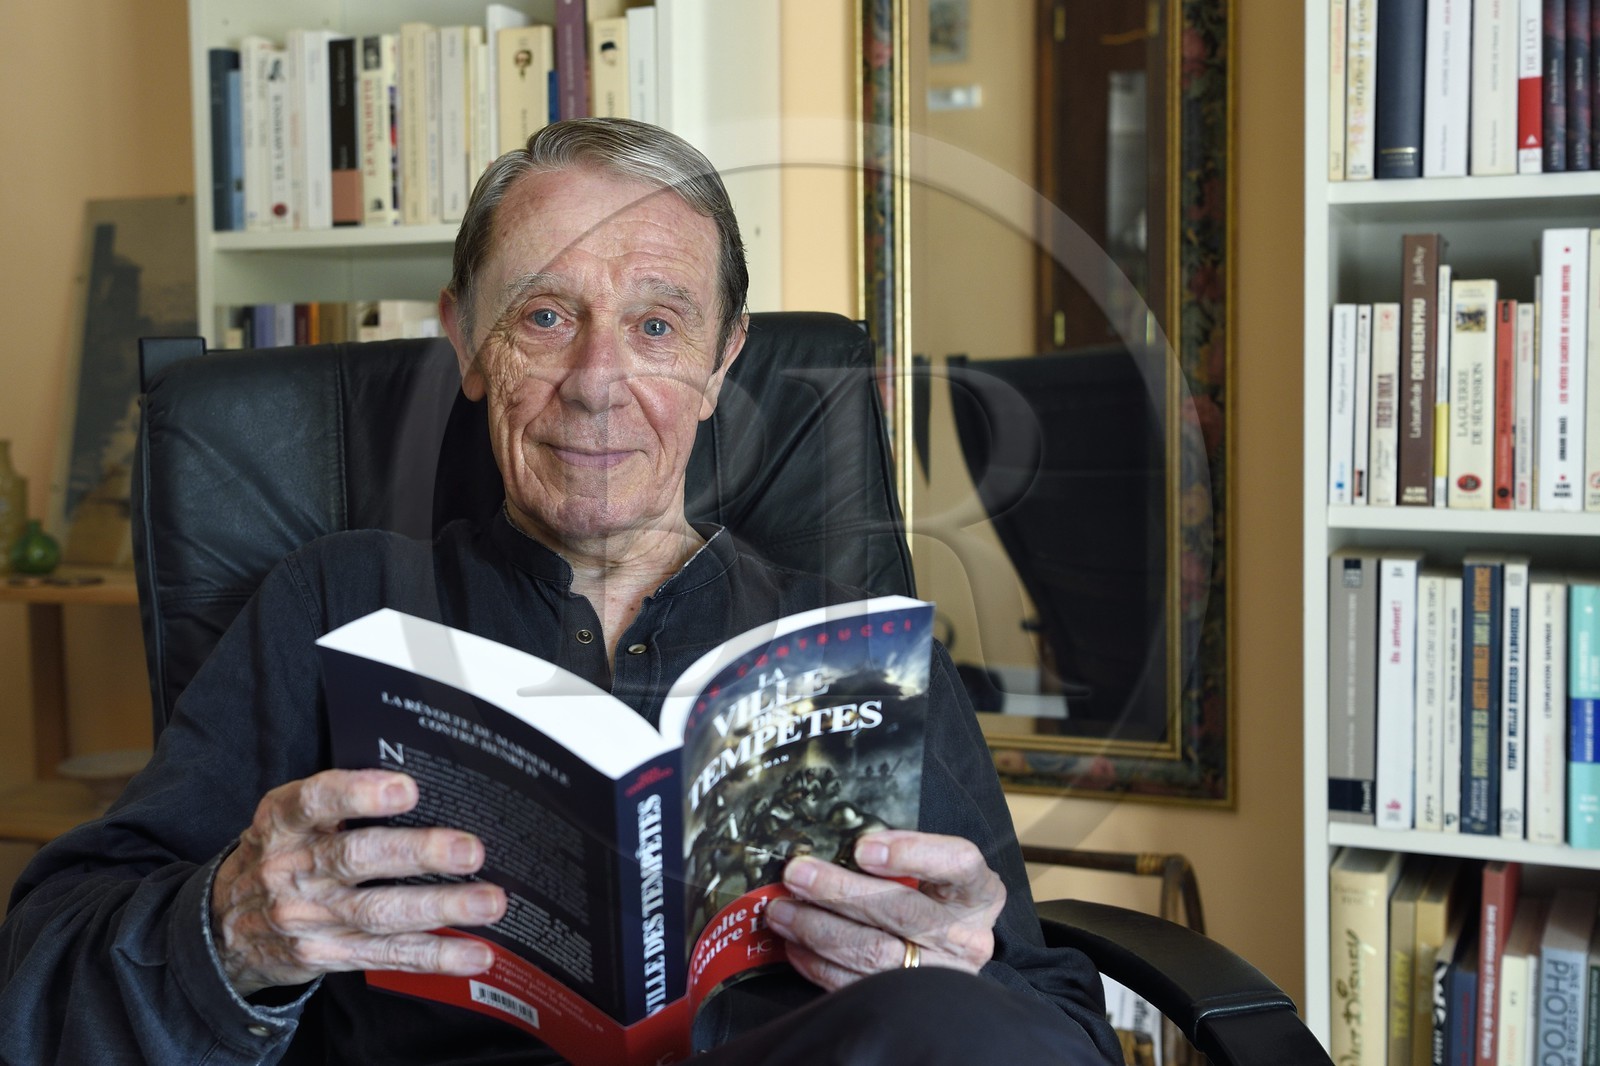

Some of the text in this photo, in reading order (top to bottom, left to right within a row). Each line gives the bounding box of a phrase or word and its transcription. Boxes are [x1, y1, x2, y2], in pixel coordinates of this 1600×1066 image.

[1411, 298, 1426, 325] PHU
[1411, 325, 1425, 352] BIEN
[1410, 352, 1425, 380] DIEN
[1457, 369, 1469, 438] LA GUERRE
[1472, 429, 1482, 446] DE
[758, 667, 785, 689] LA
[712, 667, 830, 738] VILLE
[1487, 904, 1497, 922] Les
[642, 912, 666, 960] DES
[1485, 923, 1497, 961] artistes
[1485, 962, 1495, 975] et
[1570, 963, 1581, 990] UNE
[1484, 1015, 1495, 1029] de
[1568, 993, 1579, 1053] HISTOIRE
[1481, 1030, 1495, 1060] Paris
